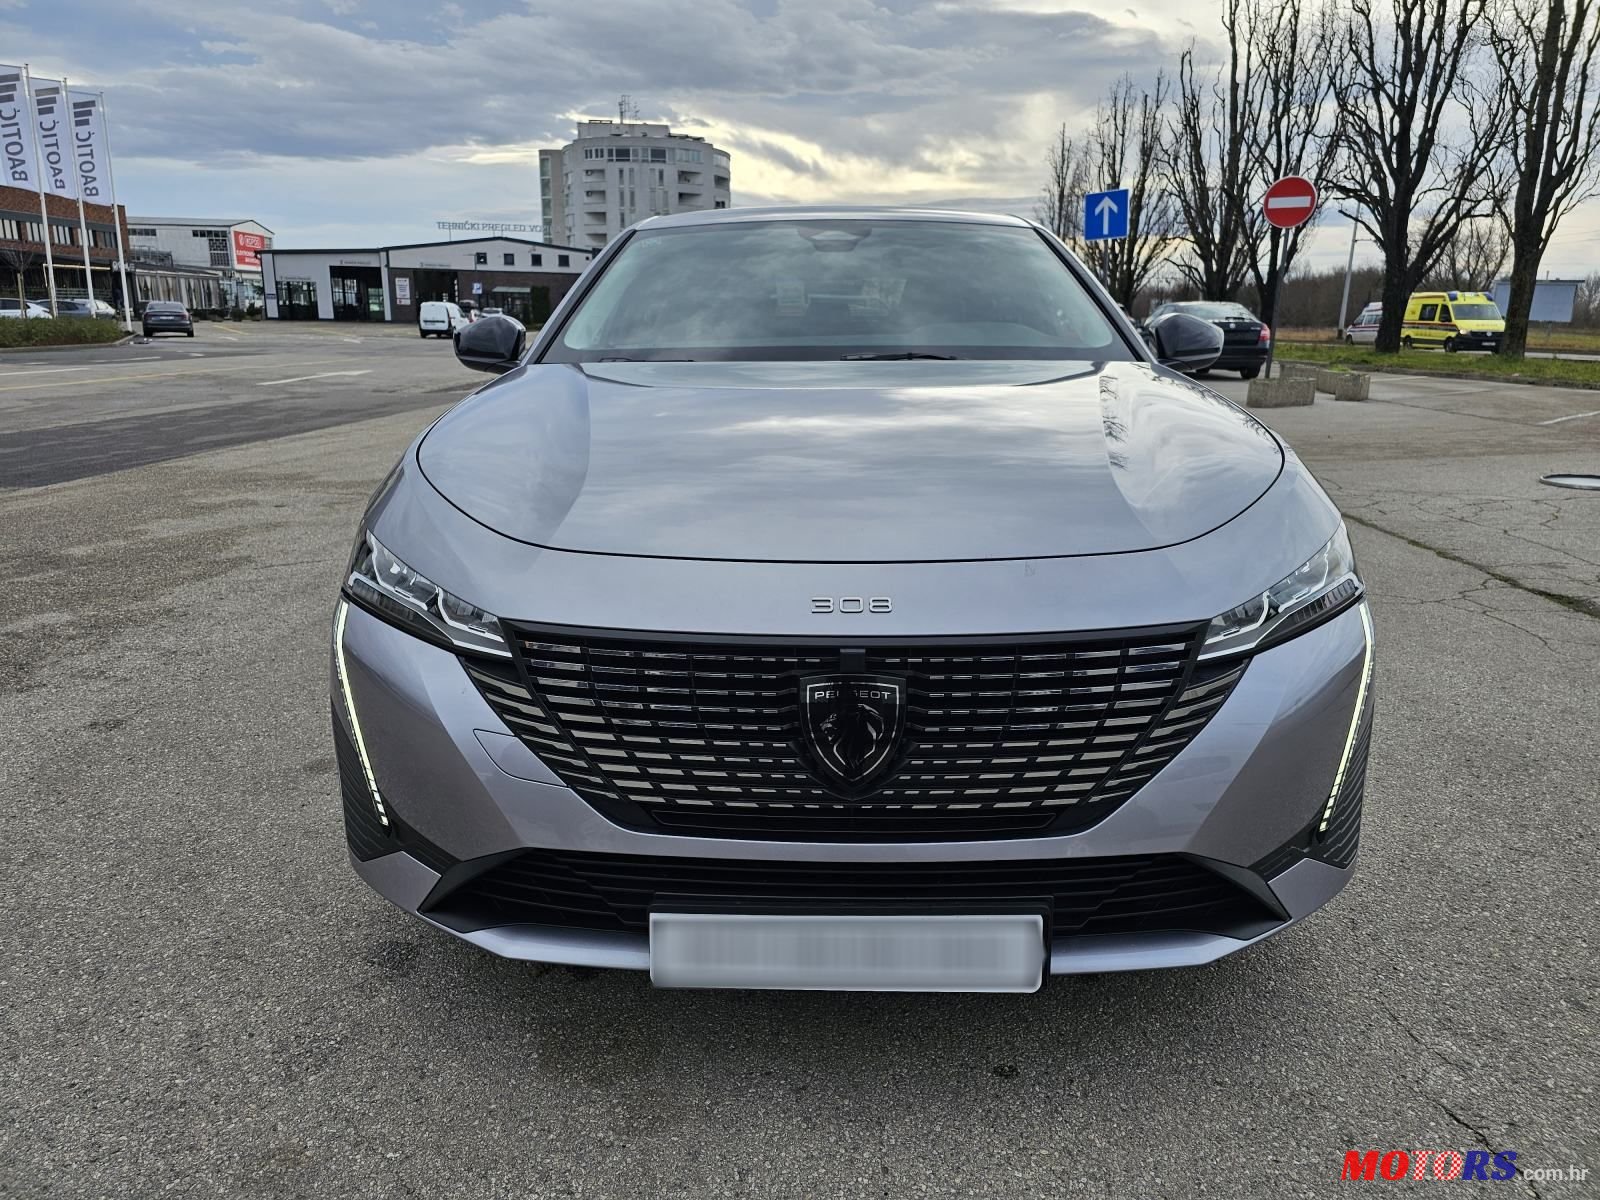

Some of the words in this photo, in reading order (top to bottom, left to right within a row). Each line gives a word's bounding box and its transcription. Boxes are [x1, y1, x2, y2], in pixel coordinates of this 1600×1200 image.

[437, 220, 479, 231] TEHNIČKI
[481, 223, 526, 232] PREGLED
[811, 597, 893, 614] 308
[814, 690, 892, 700] PEEOT
